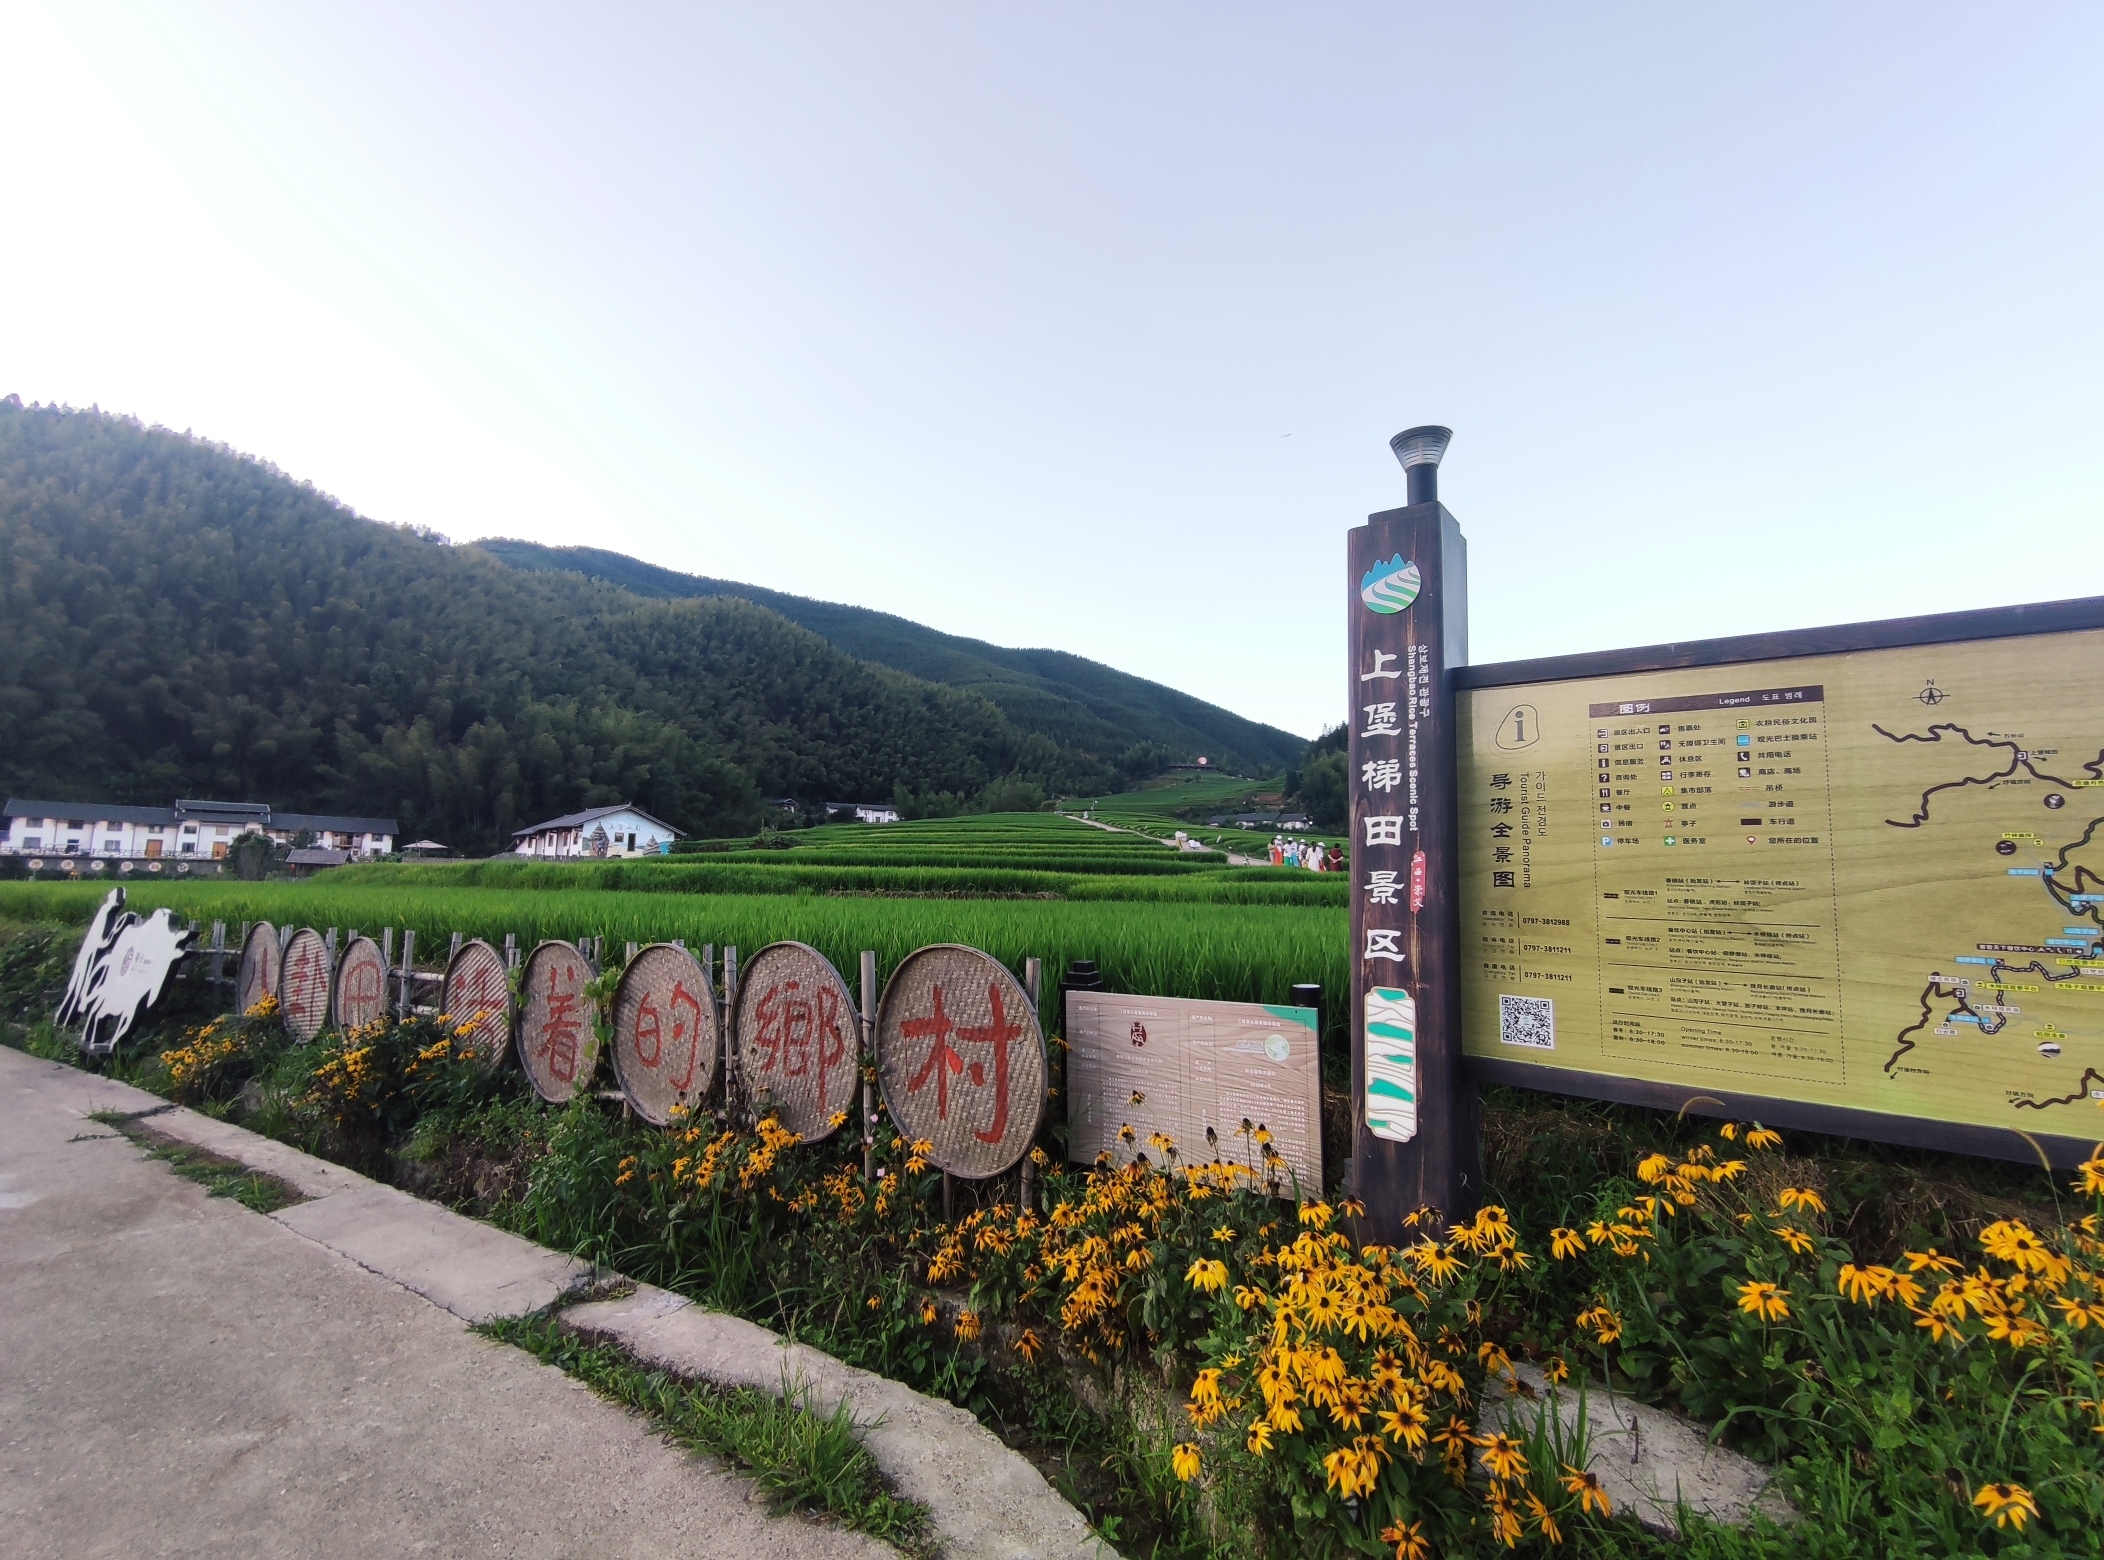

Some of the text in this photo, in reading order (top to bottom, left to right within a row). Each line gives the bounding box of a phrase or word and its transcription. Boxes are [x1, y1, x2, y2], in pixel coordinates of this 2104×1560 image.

[1407, 645, 1419, 831] Shangbao Rice Terraces Scenic Spot
[1619, 702, 1650, 715] 图例
[1719, 696, 1750, 705] Legend
[1361, 649, 1406, 963] 上堡梯田景区
[1489, 773, 1515, 888] 导游全景图
[1520, 772, 1532, 888] Tourist Guide Panorama
[1617, 837, 1640, 845] 停车场
[1522, 917, 1570, 926] 0797-3812988
[1523, 944, 1571, 954] 0797-3811211
[1524, 971, 1572, 981] 0797-3811211
[635, 980, 701, 1092] 的
[899, 982, 1022, 1144] 村
[1680, 1026, 1705, 1035] Opening
